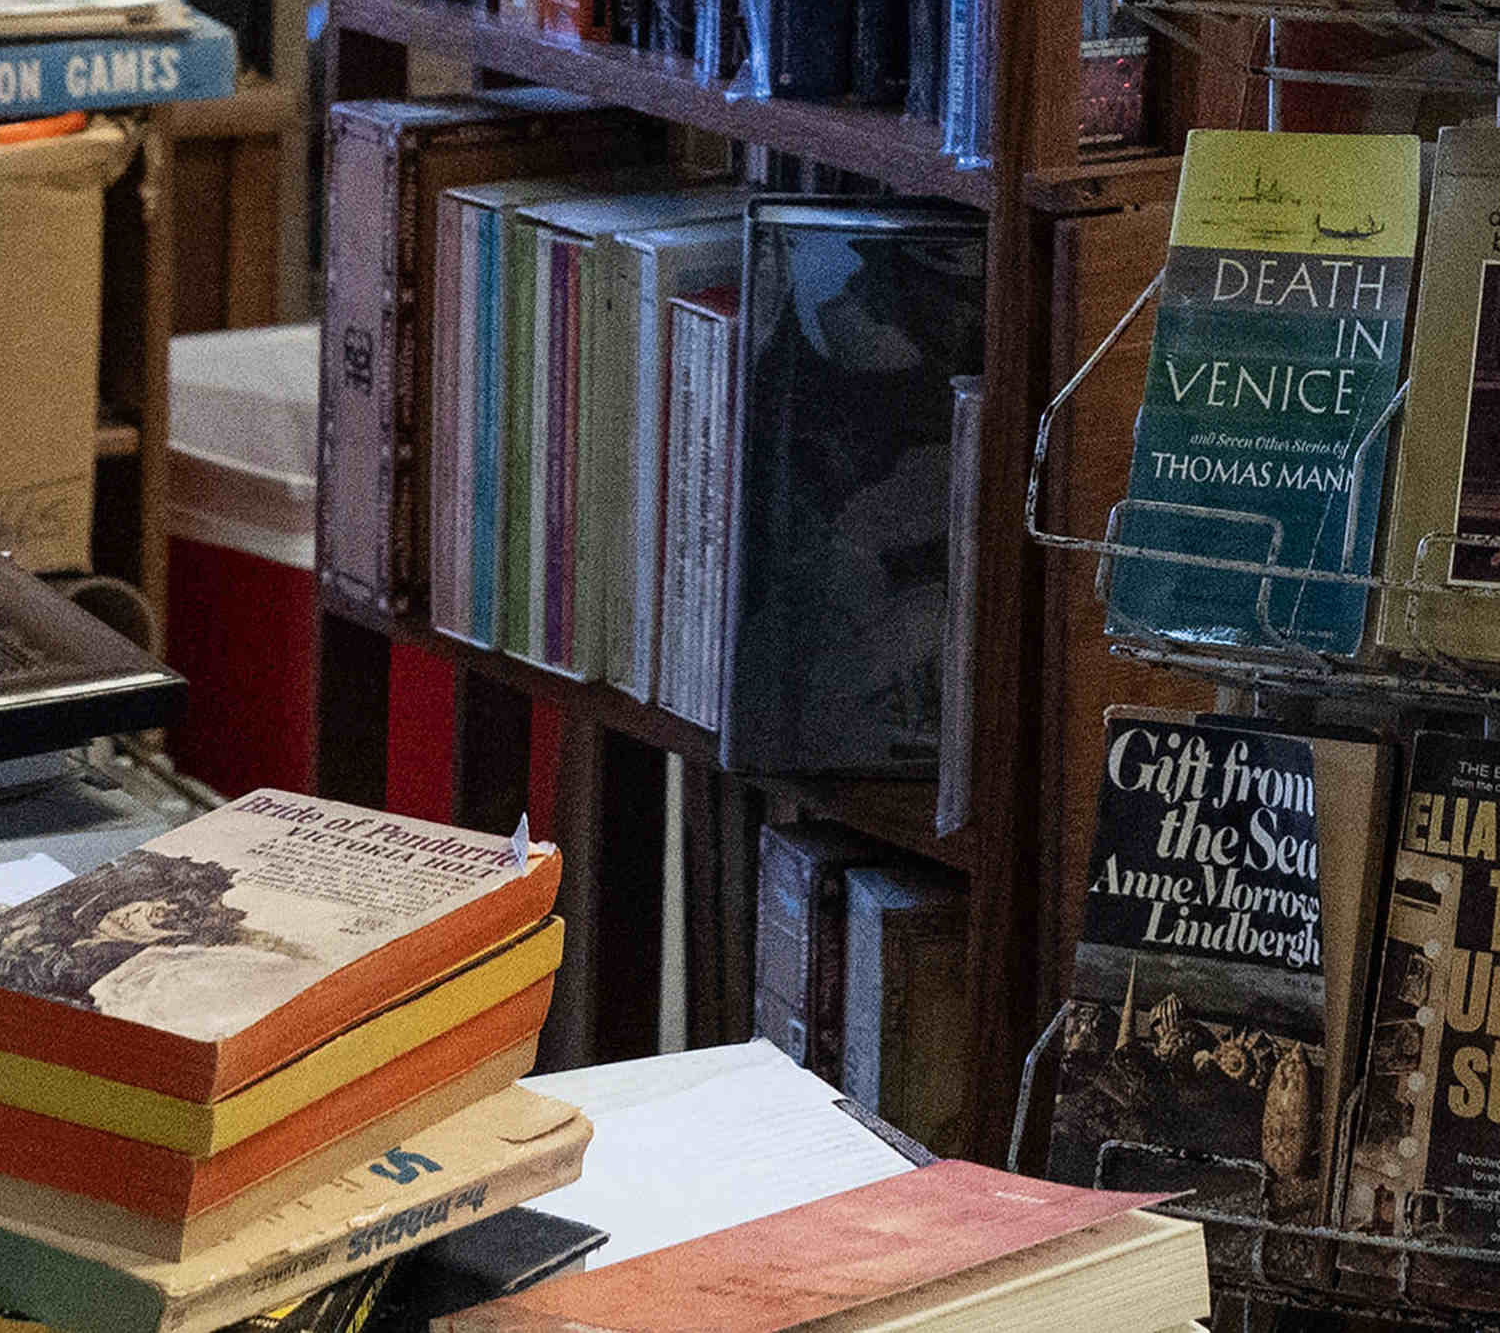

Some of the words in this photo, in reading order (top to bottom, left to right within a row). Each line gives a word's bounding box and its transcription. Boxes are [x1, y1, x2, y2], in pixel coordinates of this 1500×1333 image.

[65, 46, 181, 99] GAMES
[1212, 258, 1386, 310] DEATH
[1335, 318, 1388, 361] IN
[1165, 353, 1357, 416] VENICE
[1189, 432, 1217, 447] and
[1219, 434, 1253, 450] Seven
[1255, 437, 1290, 452] Other
[1291, 439, 1330, 455] Stories
[1151, 451, 1273, 490] THOMAS
[1276, 463, 1356, 494] MANN
[1107, 728, 1209, 803] Gift
[1213, 742, 1318, 815] from
[1458, 760, 1489, 778] THE
[287, 826, 416, 863] VICTORIA
[420, 857, 504, 879] HOLT
[1156, 801, 1237, 865] the
[1242, 810, 1319, 879] Sea
[1403, 792, 1498, 862] ELIA
[1090, 854, 1193, 906] Anne
[1195, 864, 1322, 922] Morrow
[1141, 900, 1322, 969] Lindbergh
